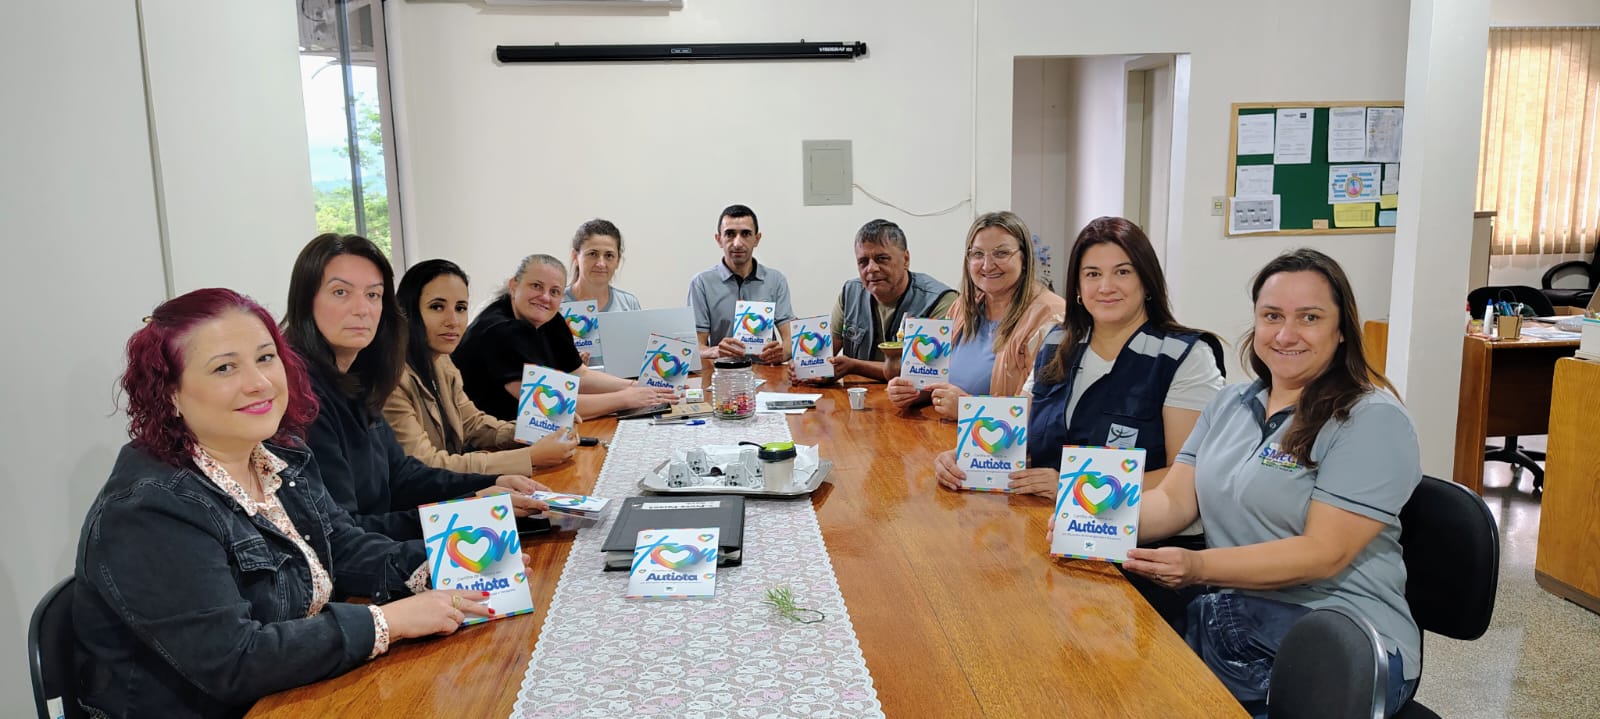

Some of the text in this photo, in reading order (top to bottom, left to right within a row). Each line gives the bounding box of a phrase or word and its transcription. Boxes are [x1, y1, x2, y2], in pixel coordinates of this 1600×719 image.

[910, 365, 939, 376] Autista
[970, 457, 1012, 470] Autista
[1067, 519, 1118, 536] Autista
[646, 571, 698, 582] Autista
